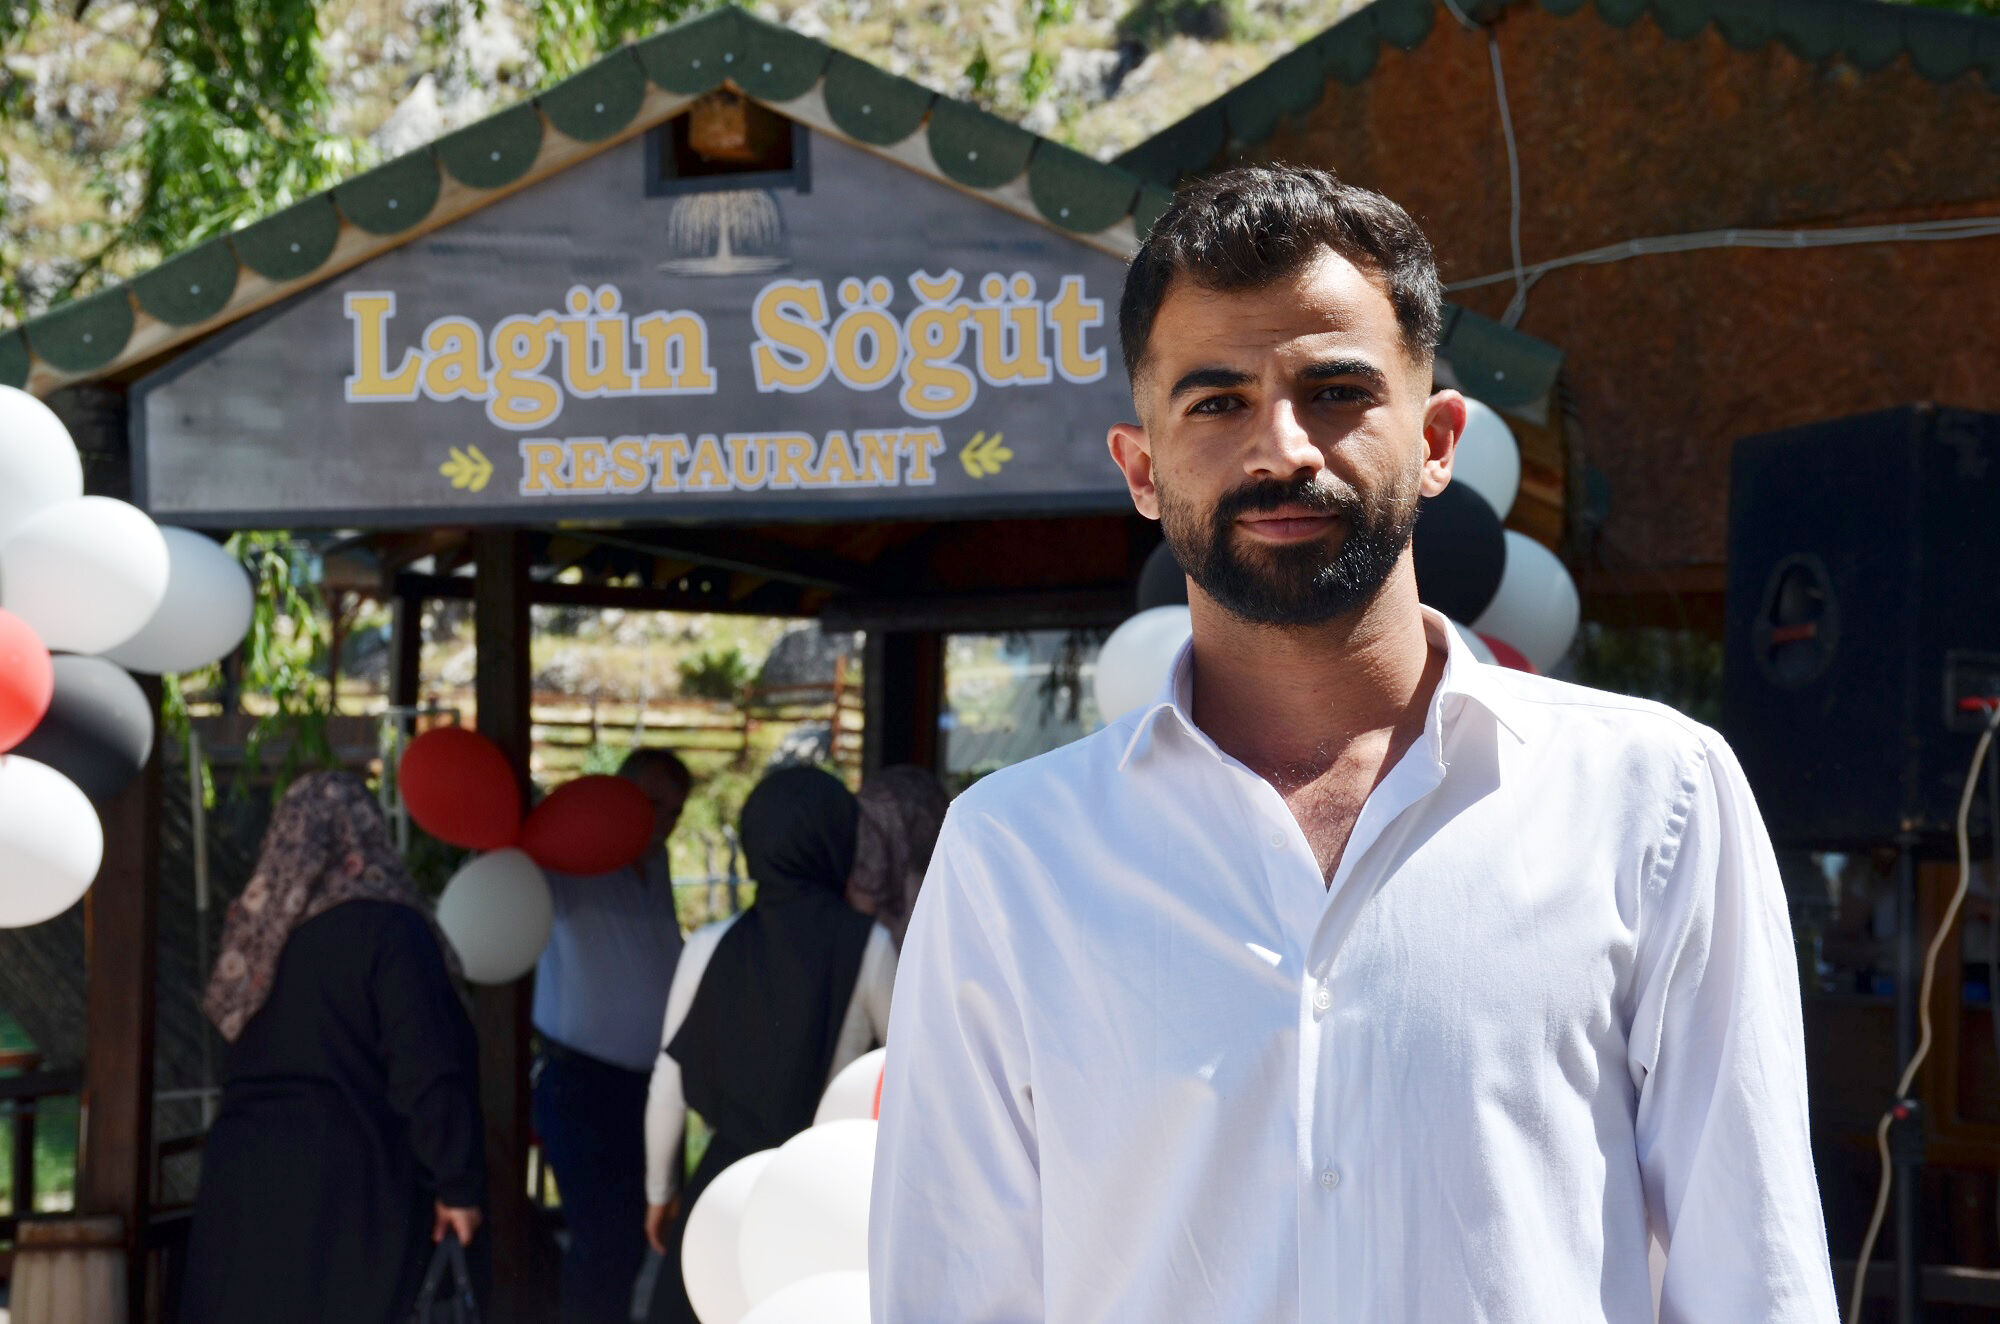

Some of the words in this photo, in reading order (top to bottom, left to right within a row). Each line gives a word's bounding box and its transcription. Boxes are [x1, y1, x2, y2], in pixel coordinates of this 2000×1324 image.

[345, 284, 718, 430] Lagün
[751, 269, 1107, 420] Söğüt
[519, 427, 946, 498] RESTAURANT
